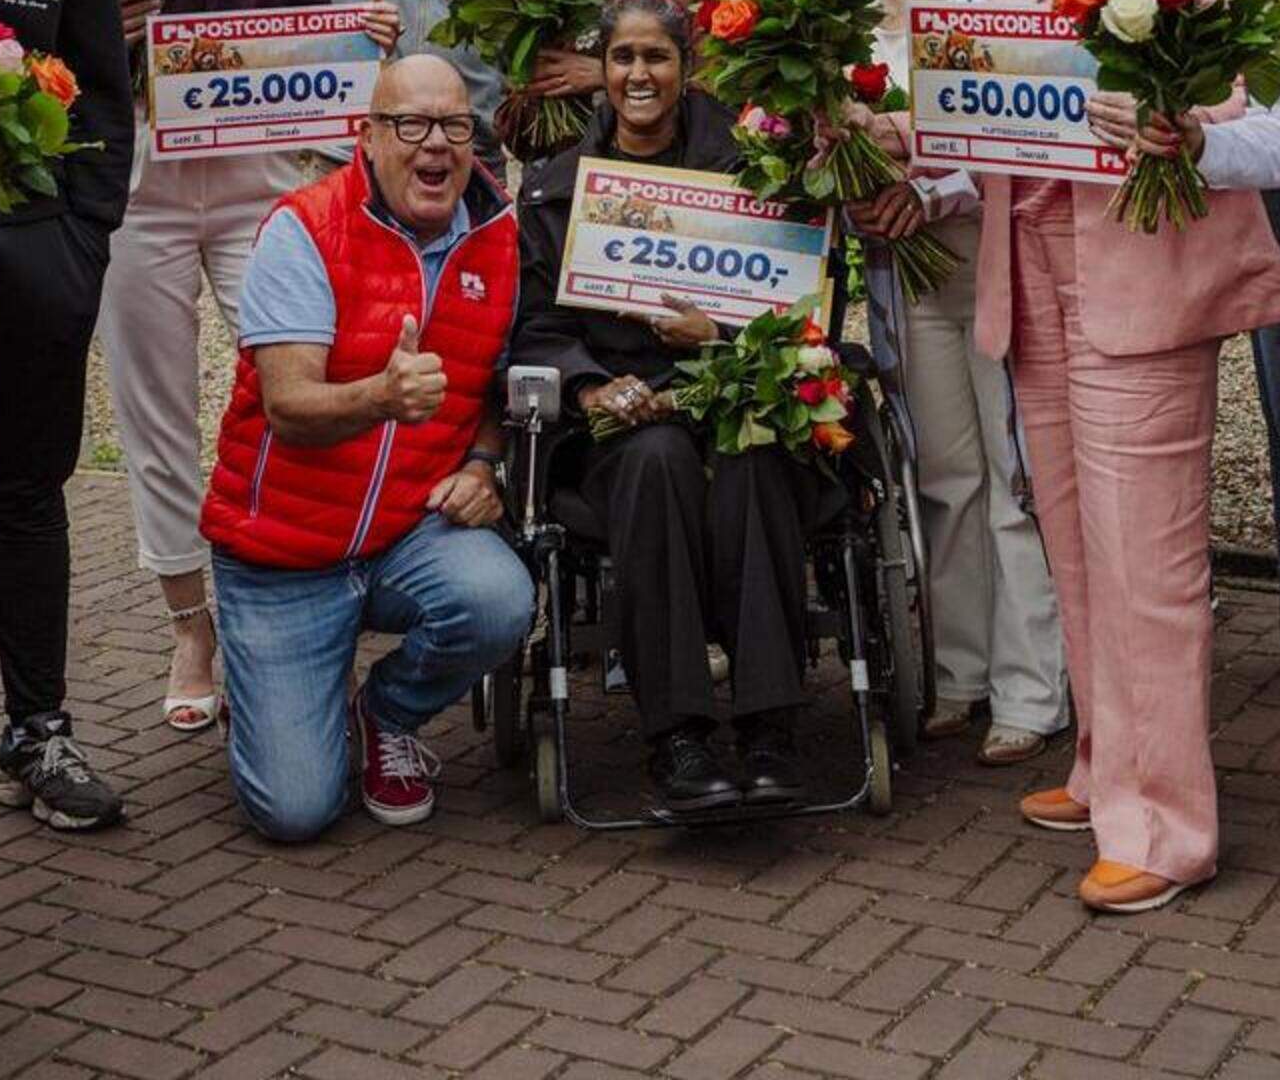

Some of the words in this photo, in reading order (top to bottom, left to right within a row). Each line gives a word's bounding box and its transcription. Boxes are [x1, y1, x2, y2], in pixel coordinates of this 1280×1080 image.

[193, 19, 295, 38] POSTCODE
[297, 12, 356, 31] LOTER
[948, 13, 1042, 36] POSTCODE
[207, 69, 354, 110] 25.000,-
[960, 78, 1087, 123] 50.000
[628, 183, 735, 211] POSTCODE
[629, 236, 790, 289] 25.000,-
